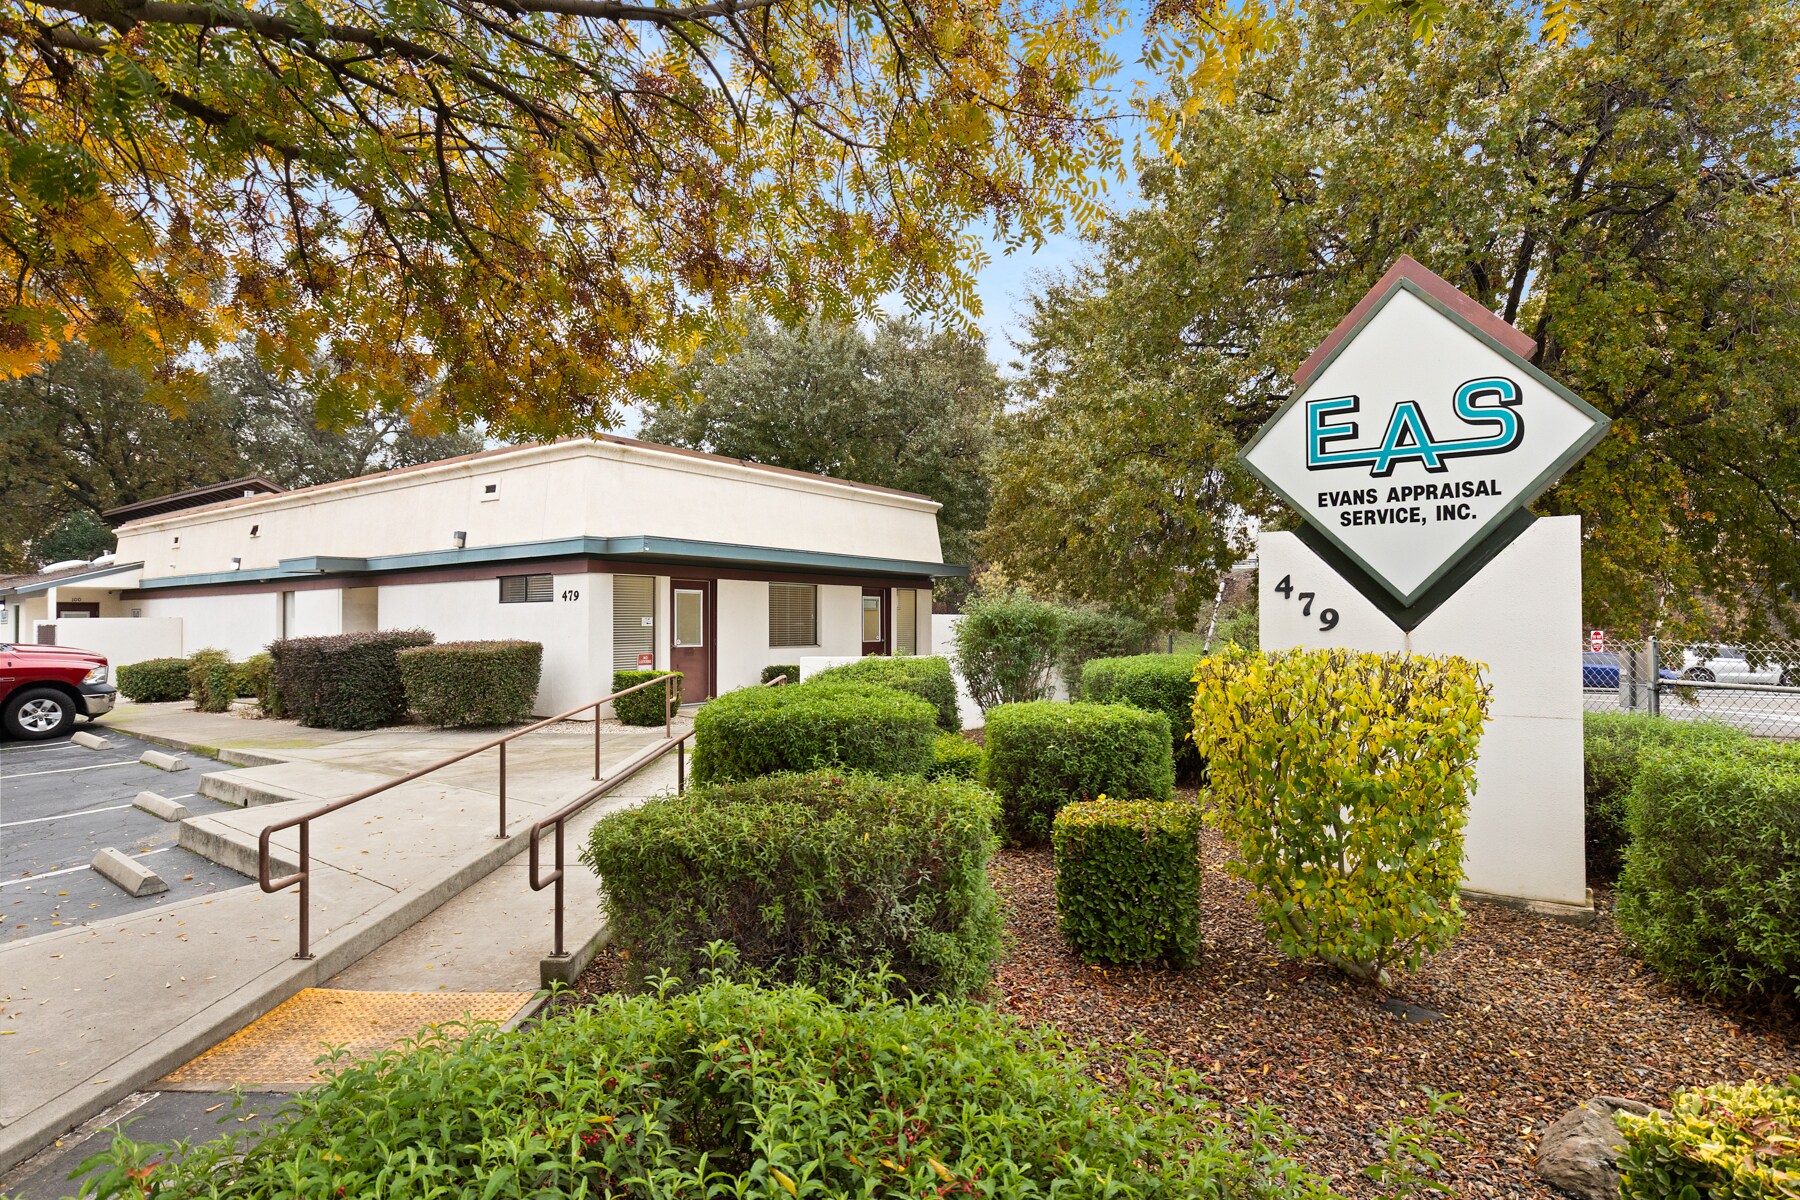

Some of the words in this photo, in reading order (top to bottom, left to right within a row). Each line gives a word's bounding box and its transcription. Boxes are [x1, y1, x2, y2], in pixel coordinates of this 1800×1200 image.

[1306, 376, 1525, 478] EAS
[1318, 488, 1378, 508] EVANS
[1387, 479, 1502, 502] APPRAISAL
[1340, 506, 1427, 527] SERVICE,
[1436, 503, 1477, 522] INC.
[562, 590, 580, 602] 479
[1274, 574, 1340, 632] 479
